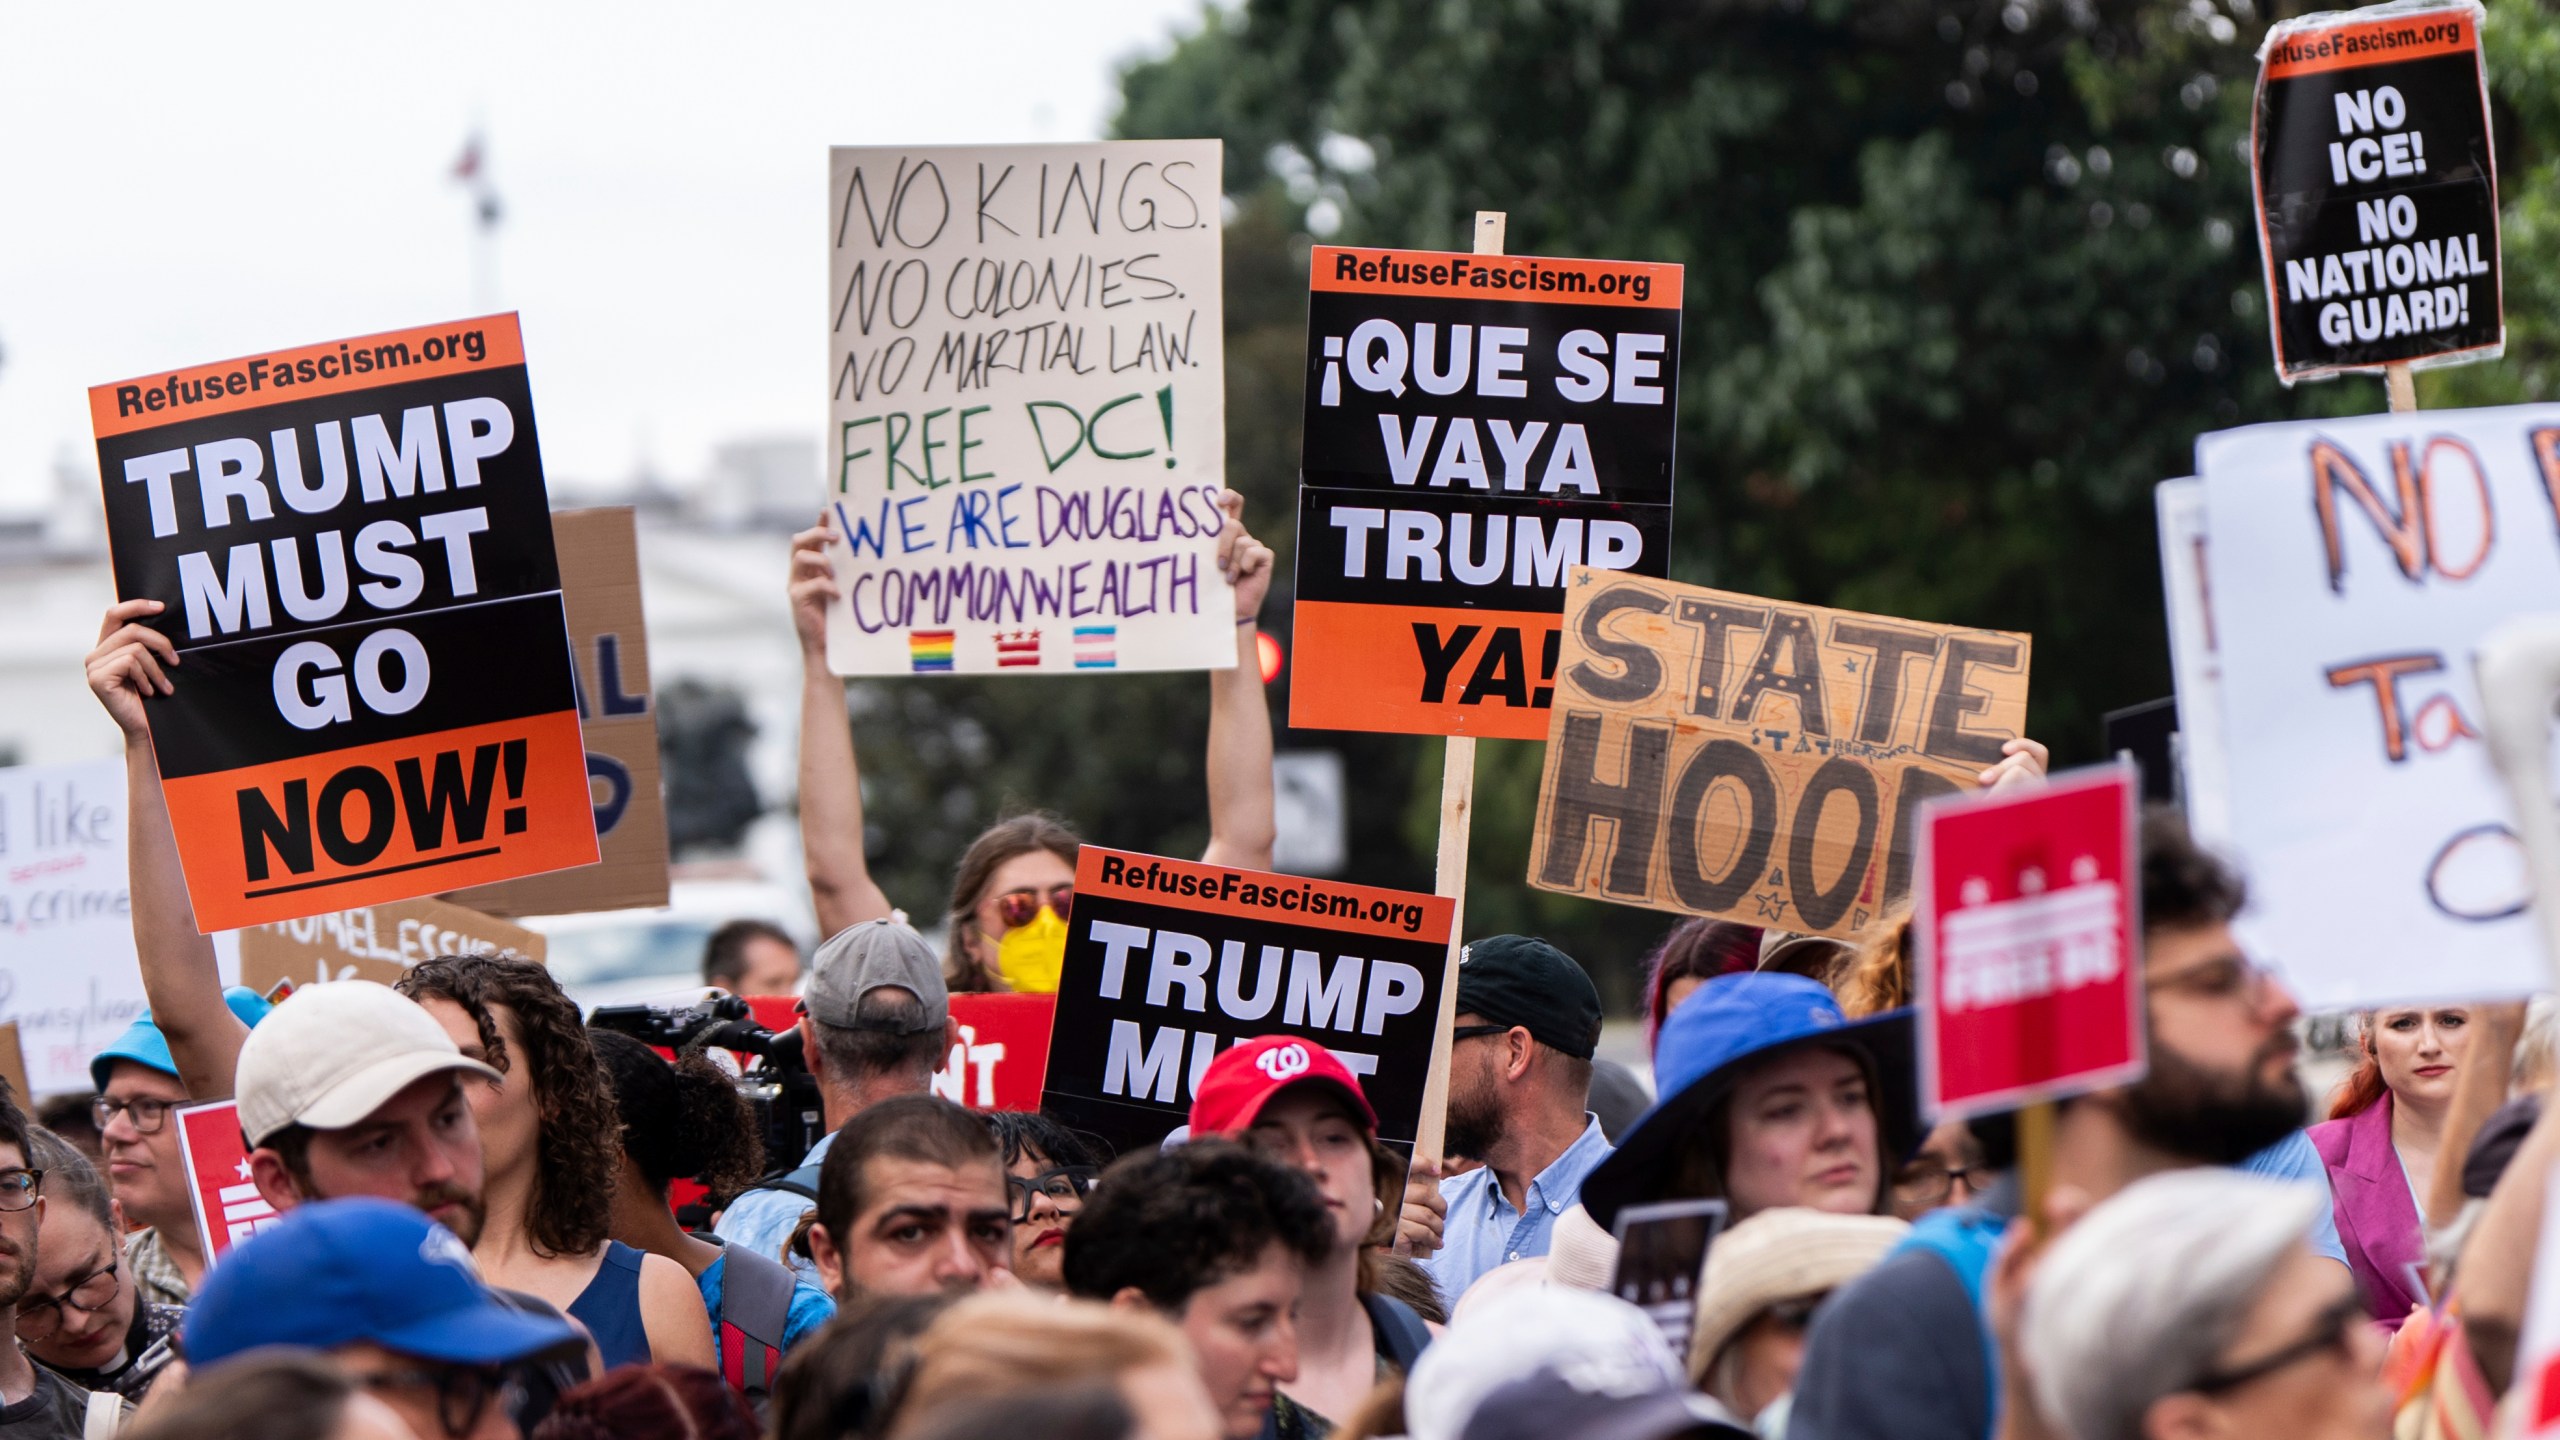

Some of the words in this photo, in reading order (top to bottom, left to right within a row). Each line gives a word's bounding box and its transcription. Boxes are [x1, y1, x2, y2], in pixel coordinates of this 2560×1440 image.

[2270, 22, 2460, 65] efuseFascism.org
[2334, 85, 2406, 136] NO
[2328, 131, 2427, 186] ICE!
[837, 156, 949, 248] NO
[977, 158, 1207, 243] KINGS.
[2357, 195, 2418, 244] NO
[834, 258, 928, 335] NO
[946, 254, 1186, 320] COLONIES.
[1335, 254, 1651, 301] RefuseFascism.org
[2285, 233, 2489, 302] NATIONAL
[835, 336, 916, 401] NO
[924, 320, 1097, 392] MARTIAL
[1111, 310, 1200, 373] LAW.
[2318, 283, 2469, 346] GUARD!
[117, 330, 487, 418] RefuseFascism.org
[1321, 318, 1530, 406] ¡QUE
[1555, 329, 1666, 405] SE
[124, 397, 515, 538] TRUMP
[840, 405, 996, 493] FREE
[1025, 383, 1178, 473] DC!
[1378, 414, 1600, 494] VAYA
[834, 496, 936, 558] WE
[946, 483, 1030, 553] ARE
[1035, 485, 1225, 548] DOUGLASS
[1330, 506, 1643, 588] TRUMP
[2308, 433, 2494, 593] NO
[178, 507, 489, 639] MUST
[852, 552, 1200, 633] COMMONWEALTH
[273, 628, 431, 730] GO
[1411, 622, 1562, 709] YA!
[1564, 581, 2025, 763] STATE
[34, 781, 113, 848] like
[236, 738, 528, 884] NOW!
[1101, 856, 1423, 933] RefuseFascism.org
[1089, 919, 1424, 1036] TRUMP
